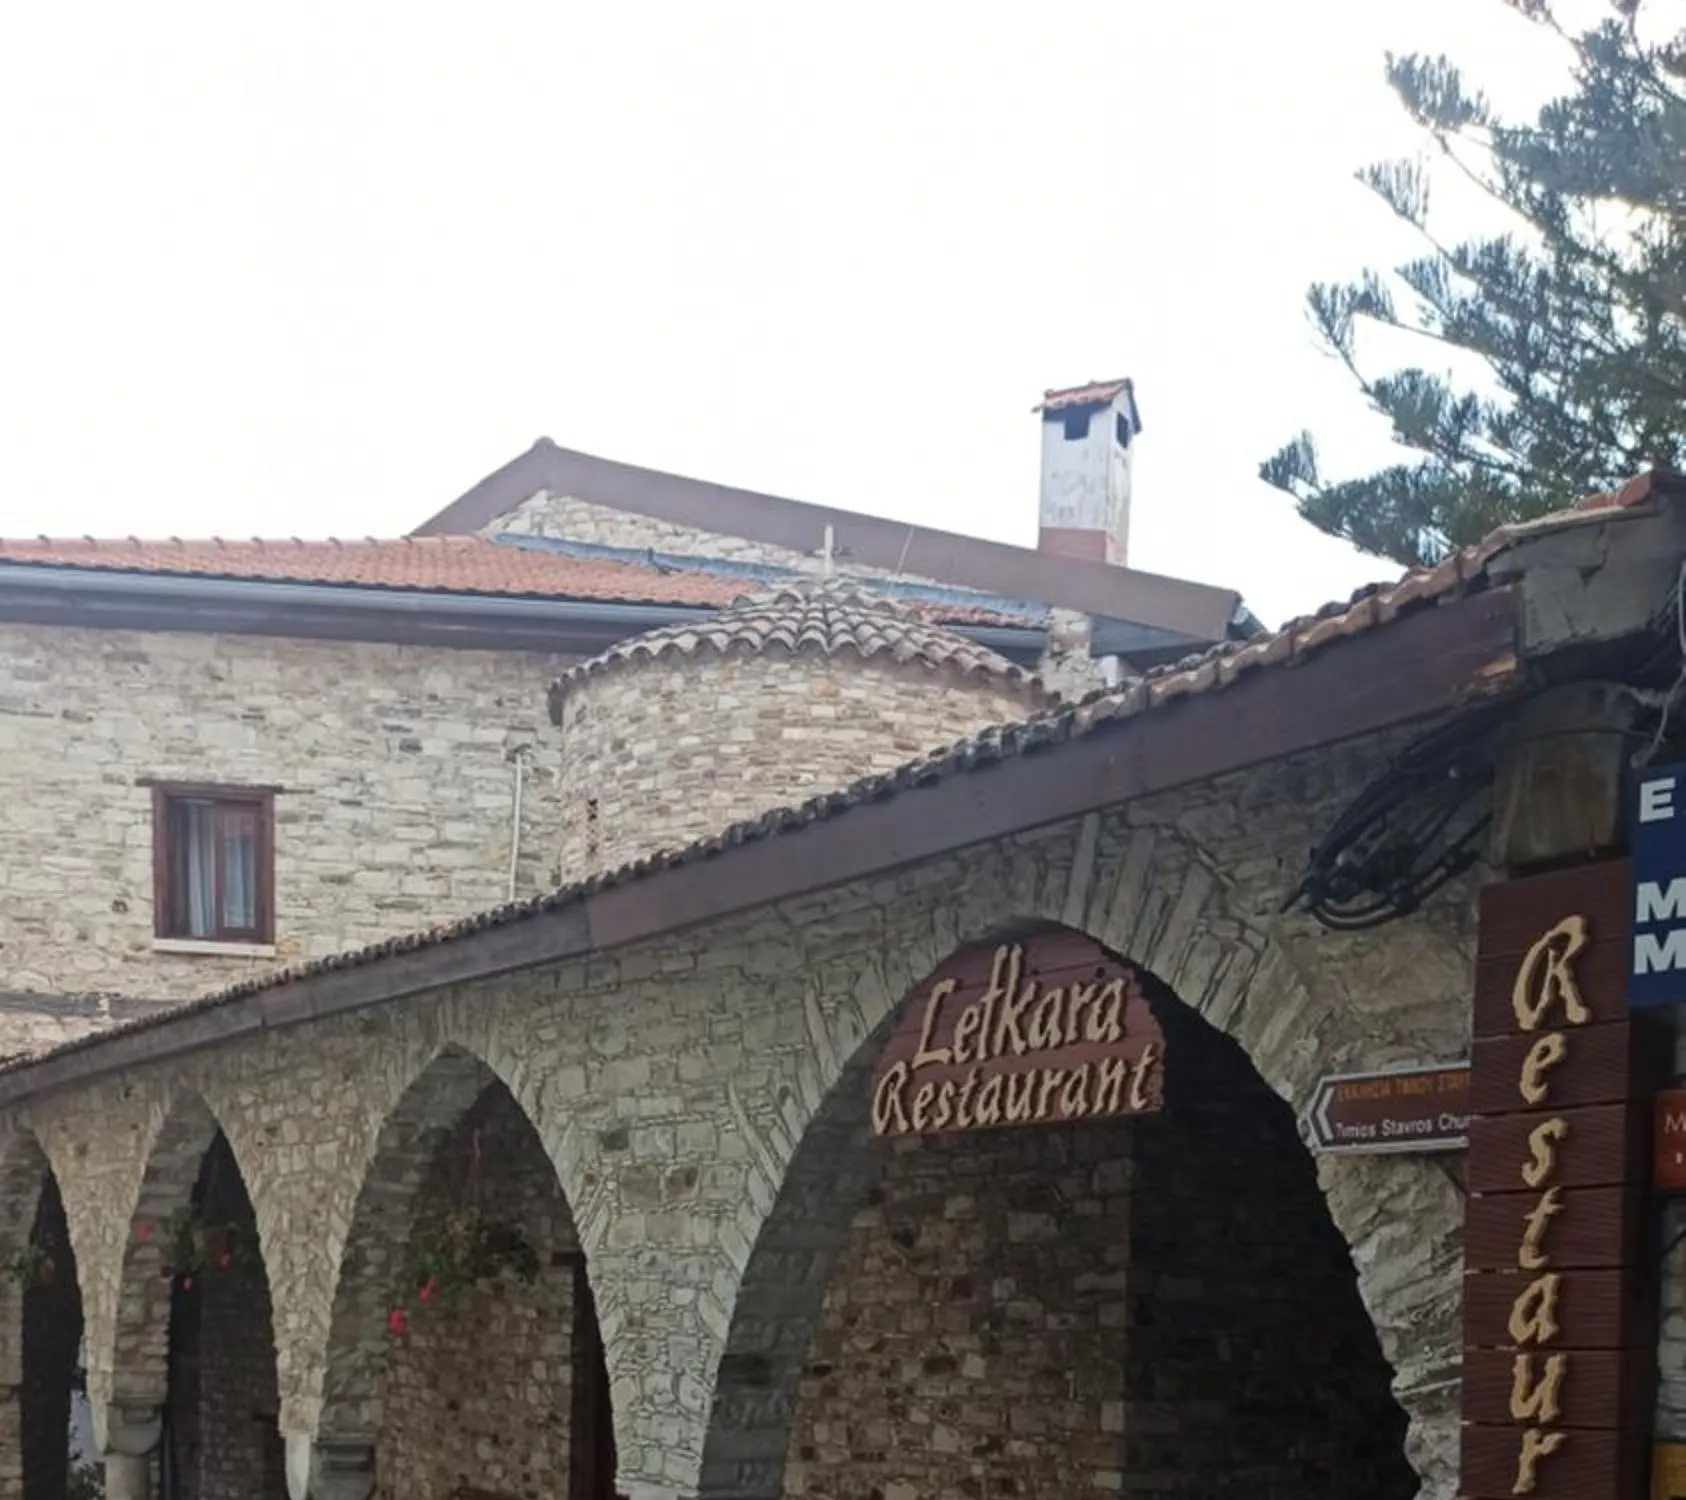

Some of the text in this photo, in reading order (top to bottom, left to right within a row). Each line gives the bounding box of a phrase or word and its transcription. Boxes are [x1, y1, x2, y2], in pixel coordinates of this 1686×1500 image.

[911, 943, 1125, 1069] Lefkara
[871, 1043, 1157, 1136] Restaurant
[1335, 1112, 1469, 1138] Timios Stavros Chu
